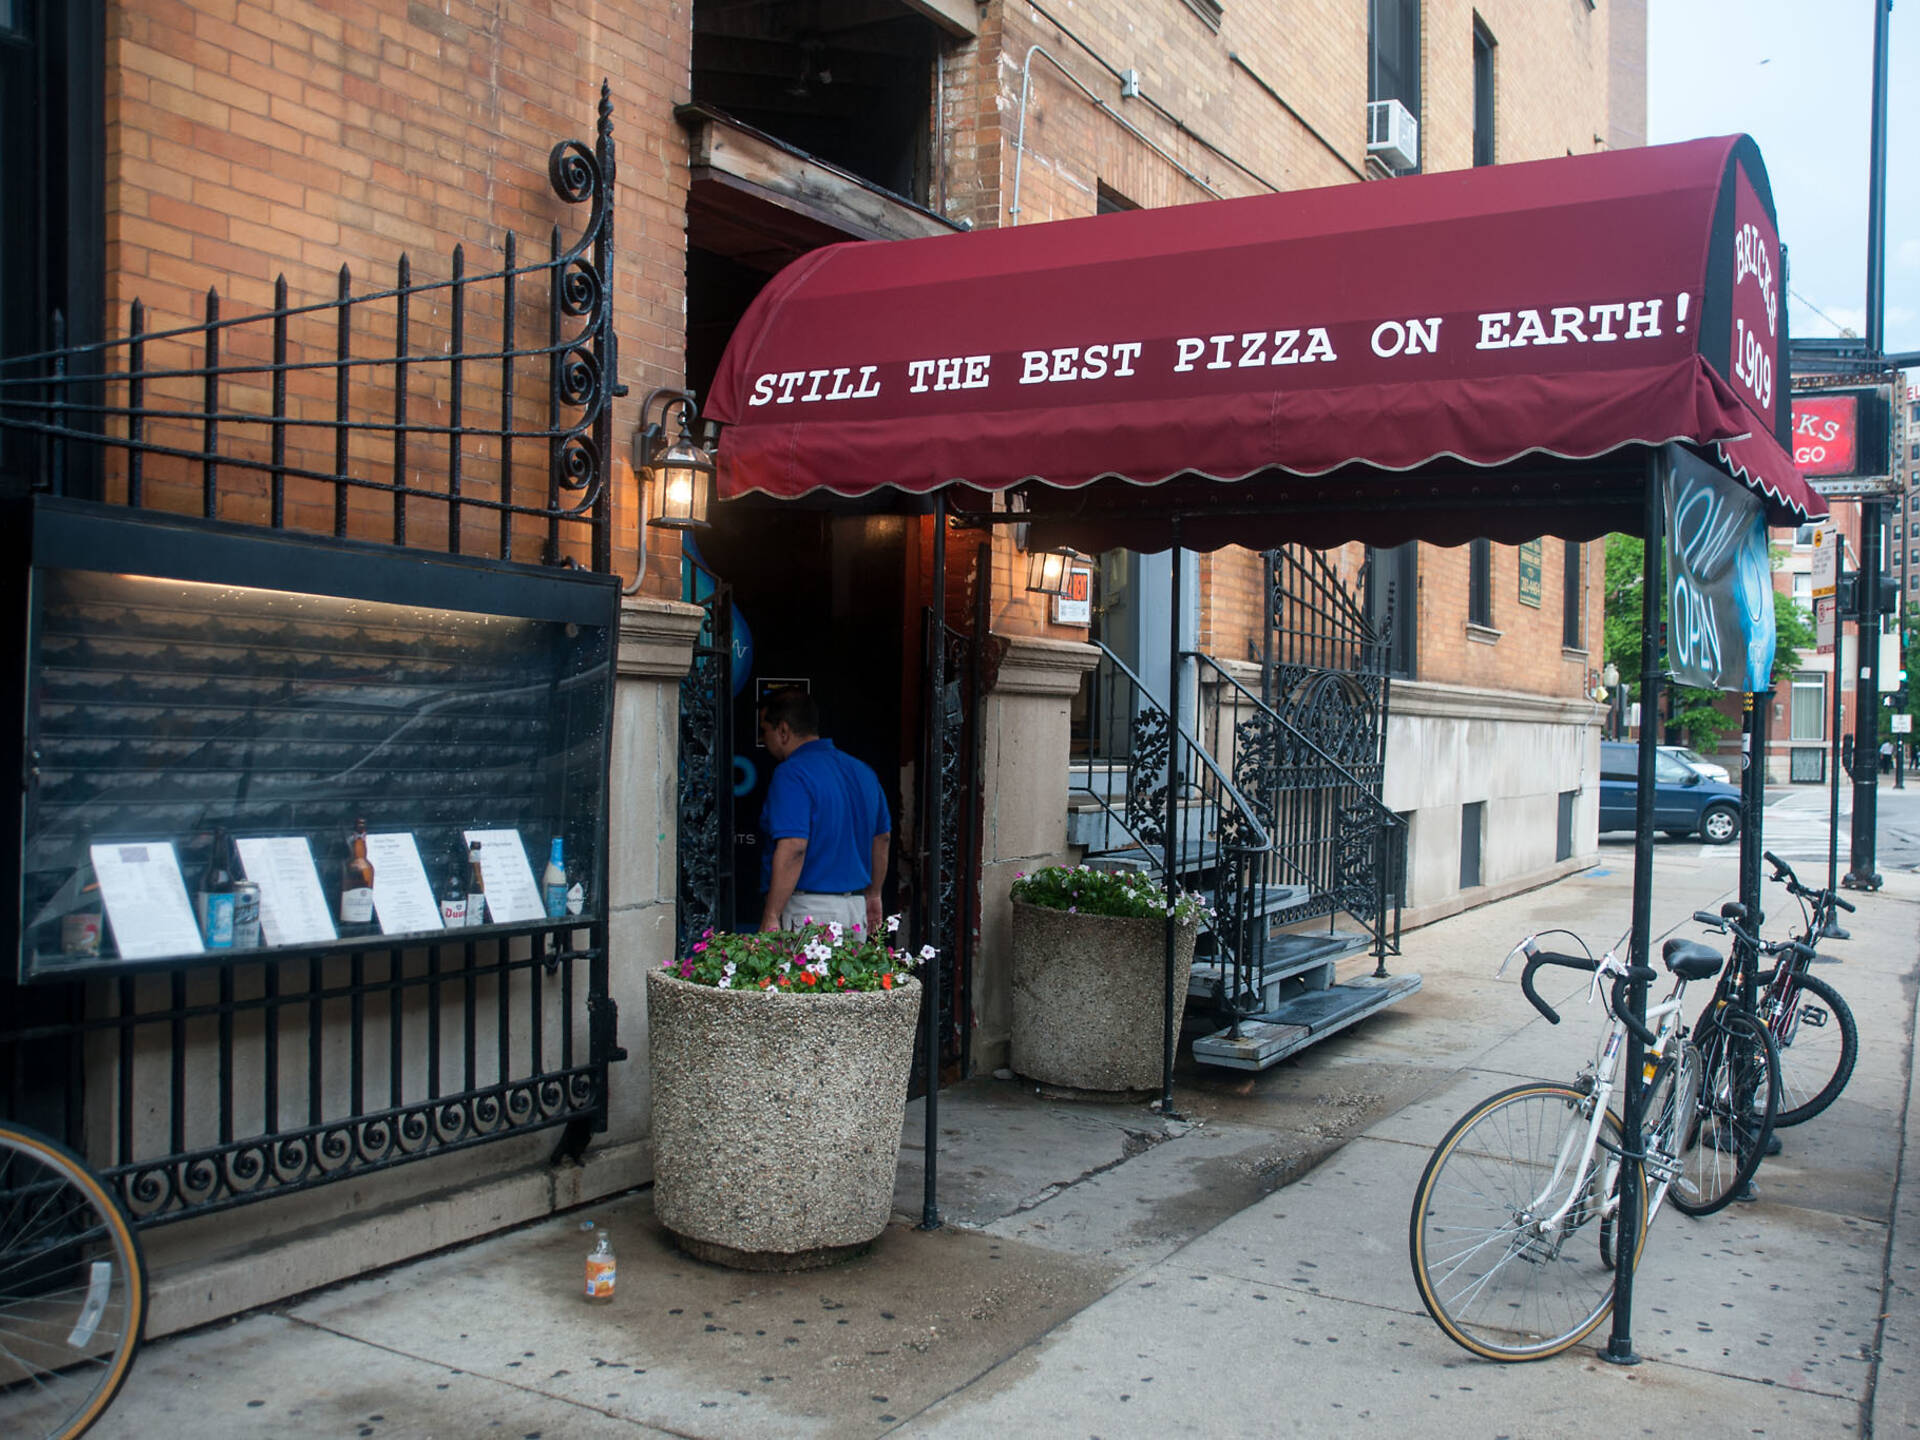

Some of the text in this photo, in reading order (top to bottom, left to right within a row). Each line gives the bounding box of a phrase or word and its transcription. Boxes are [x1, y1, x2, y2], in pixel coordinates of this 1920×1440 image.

[1735, 223, 1776, 337] BRICKS
[748, 365, 881, 406] STILL
[908, 355, 991, 393] THE
[1019, 342, 1142, 385] BEST
[1173, 327, 1338, 372] PIZZA
[1370, 317, 1443, 358] ON
[1735, 318, 1771, 409] 1909
[1791, 412, 1840, 442] KS
